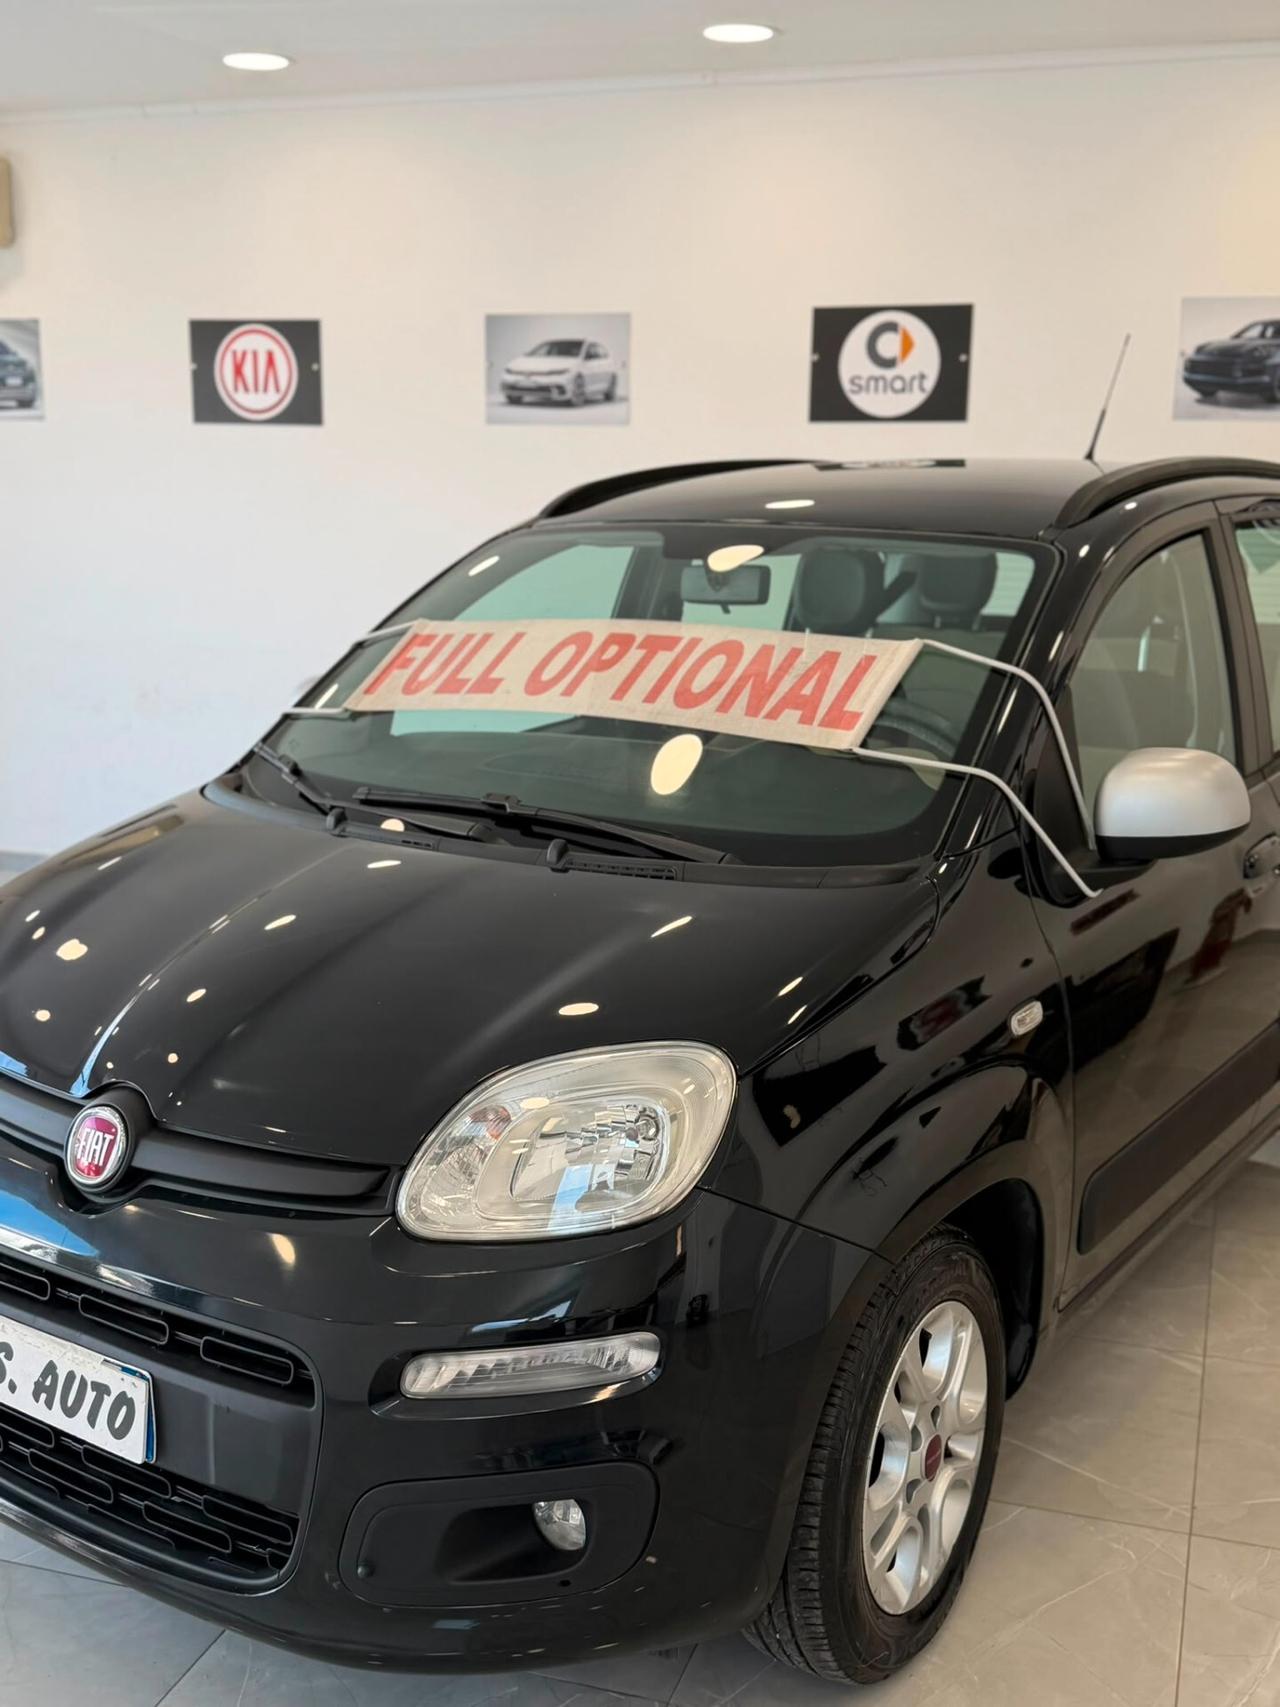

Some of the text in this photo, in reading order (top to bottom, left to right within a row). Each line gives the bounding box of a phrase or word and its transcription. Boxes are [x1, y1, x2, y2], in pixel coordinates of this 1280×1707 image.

[232, 350, 281, 393] KIA
[849, 372, 926, 394] smart
[363, 631, 877, 731] FULL OPTIONAL
[77, 1127, 115, 1167] FIAT
[32, 1359, 136, 1441] AUTO
